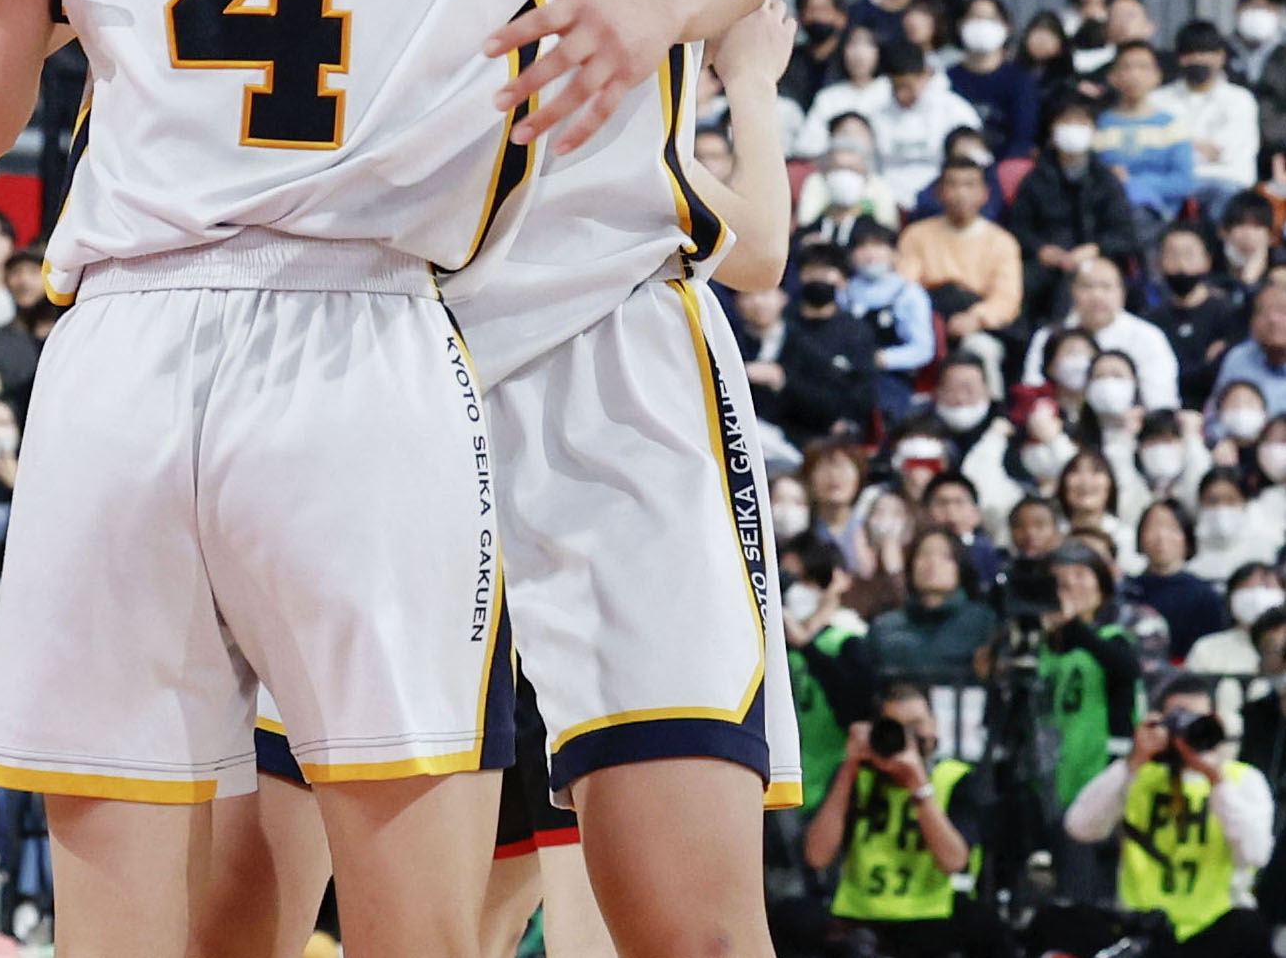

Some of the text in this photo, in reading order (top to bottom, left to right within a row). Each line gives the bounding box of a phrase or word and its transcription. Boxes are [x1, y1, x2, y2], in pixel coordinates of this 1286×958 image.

[445, 336, 492, 643] KYOTO SEIKA GAKUEN
[734, 484, 762, 563] SEIKA
